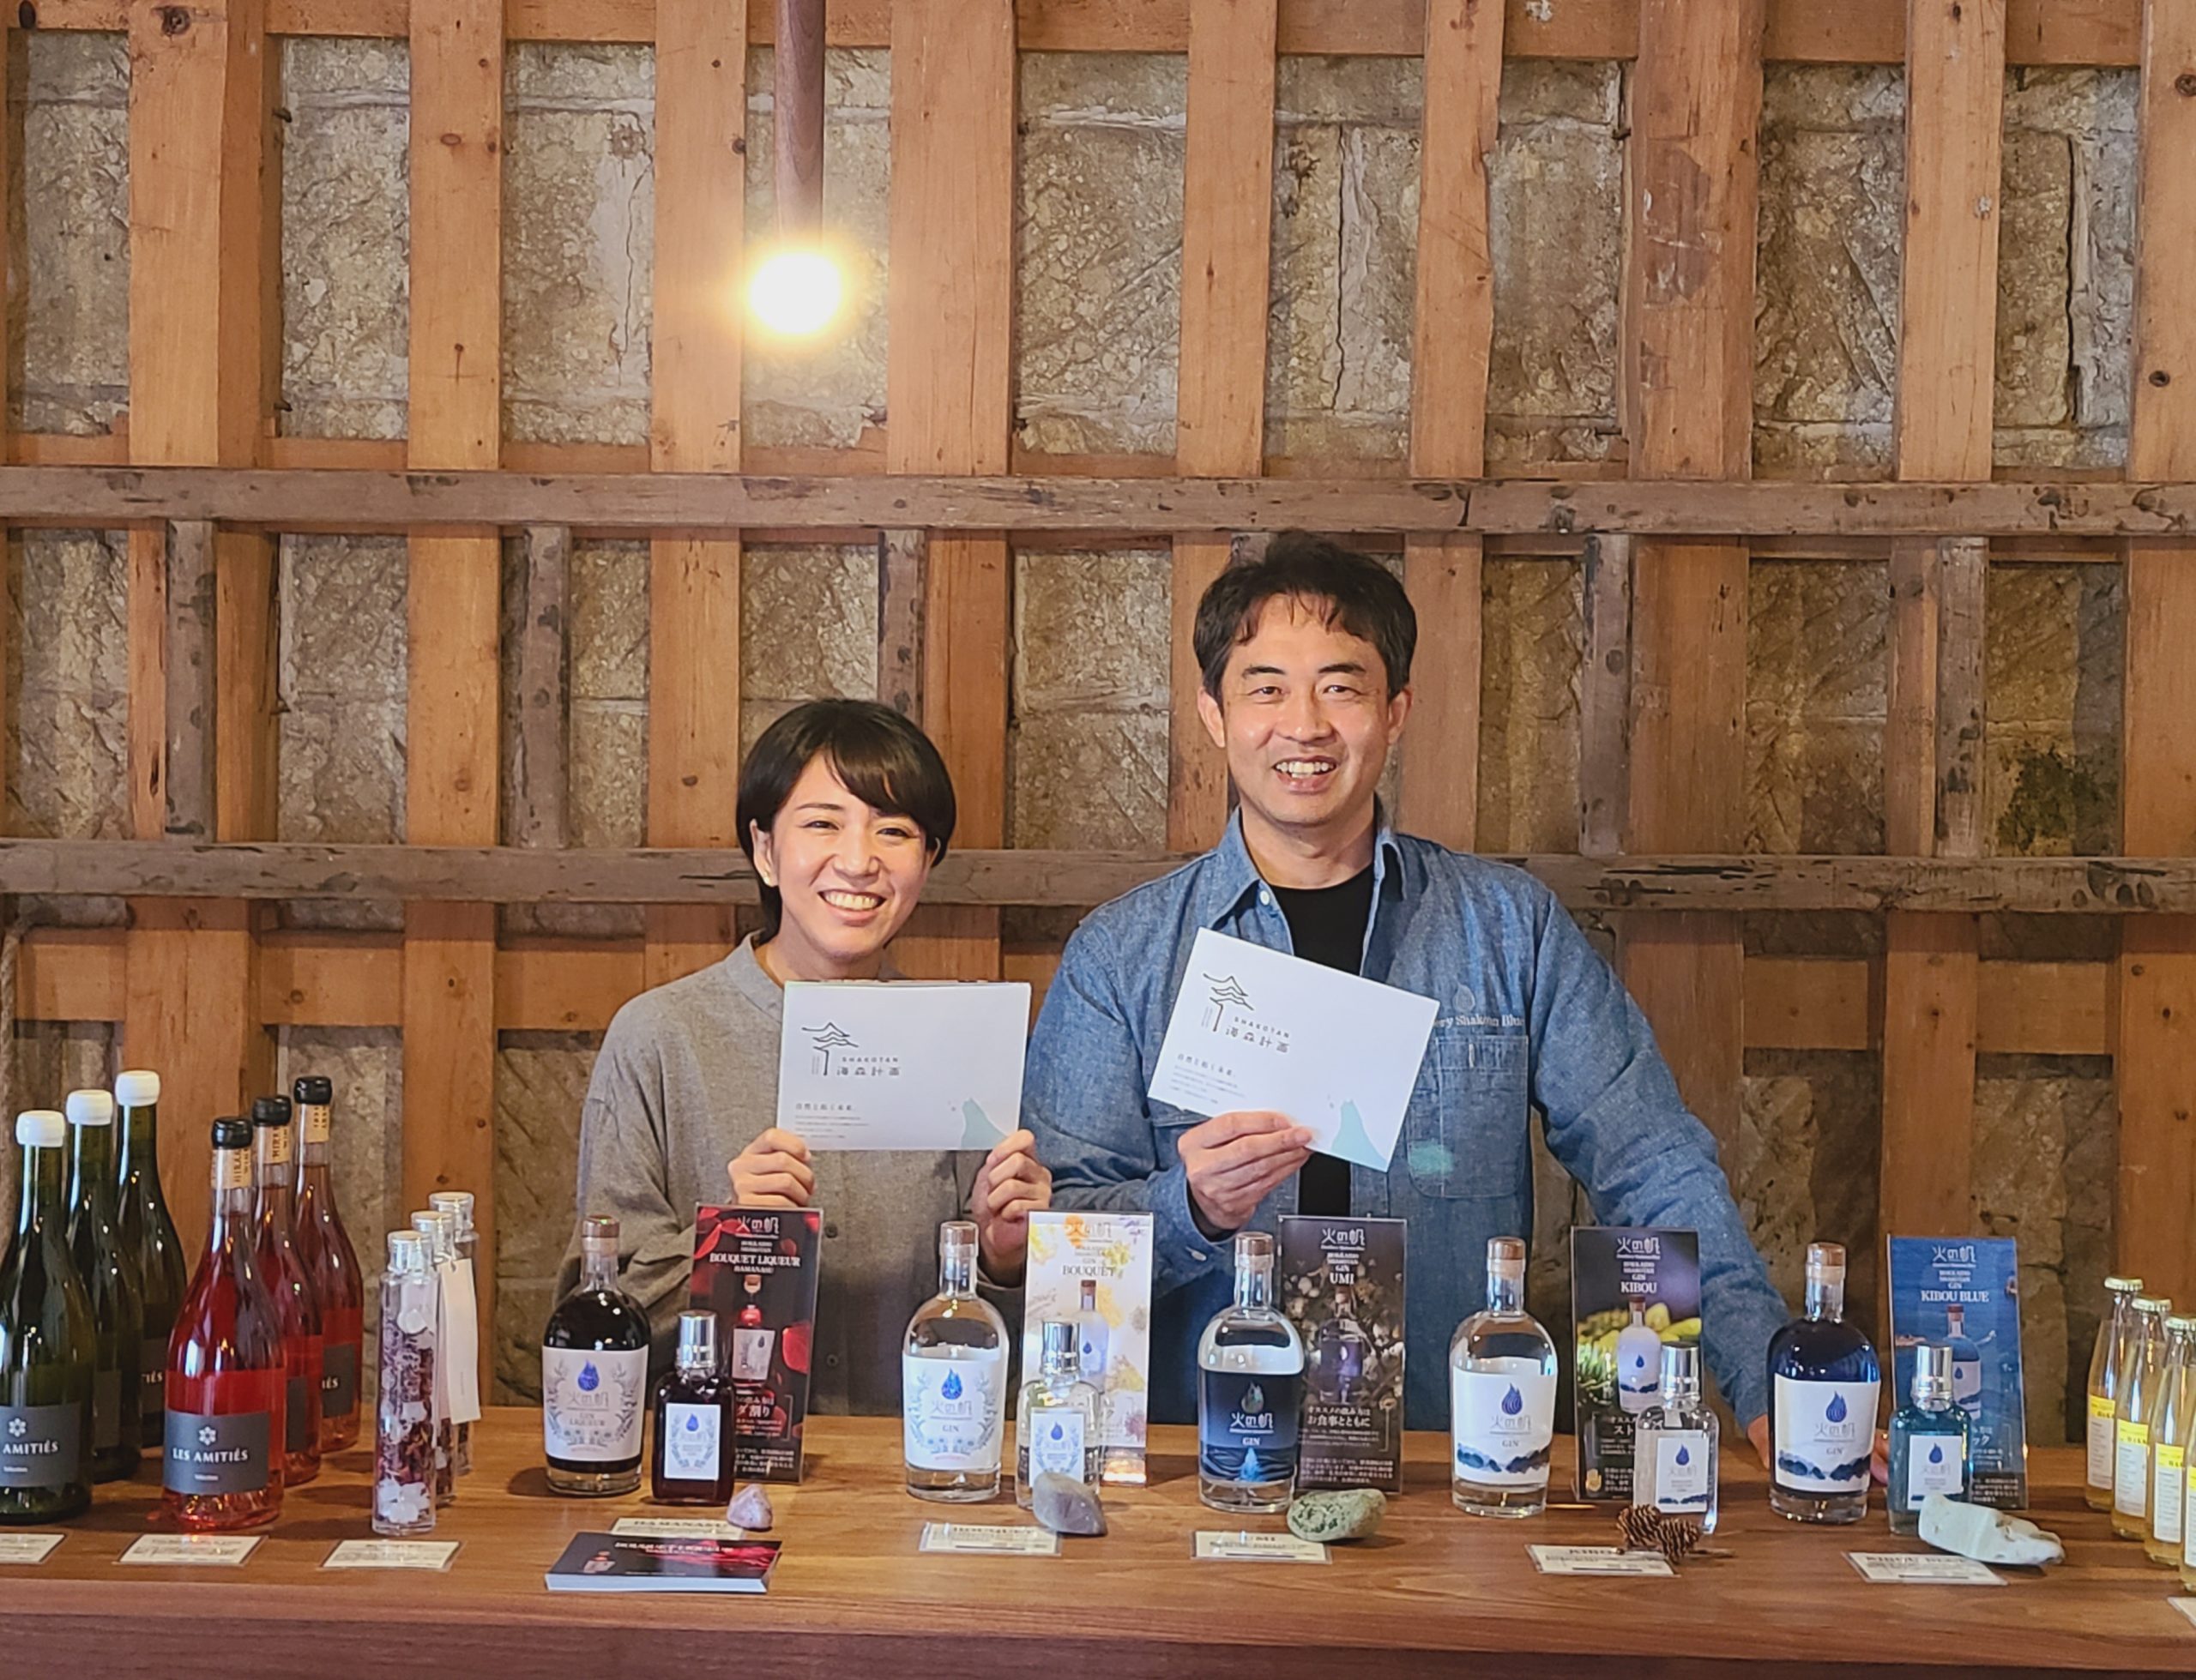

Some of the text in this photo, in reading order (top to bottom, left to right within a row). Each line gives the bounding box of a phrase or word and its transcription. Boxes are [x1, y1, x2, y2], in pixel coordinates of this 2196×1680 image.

[736, 1215, 780, 1234] 火の帆
[1321, 1227, 1366, 1246] 火の帆
[1616, 1237, 1661, 1255] 火の帆
[1932, 1244, 1976, 1263] 火の帆
[709, 1253, 801, 1268] BOUQUET LIQUEUR
[1062, 1265, 1116, 1277] BOUQUET
[1329, 1273, 1354, 1285] UMI
[1620, 1281, 1657, 1293] KIBOU
[1921, 1290, 1990, 1303] KIBOU BLUE
[1230, 1412, 1274, 1429] 火の帆
[1307, 1415, 1372, 1427] お食事とともに
[3, 1440, 58, 1455] AMITIÉS
[1242, 1436, 1261, 1446] GIN
[172, 1447, 249, 1462] LES AMITIÉS
